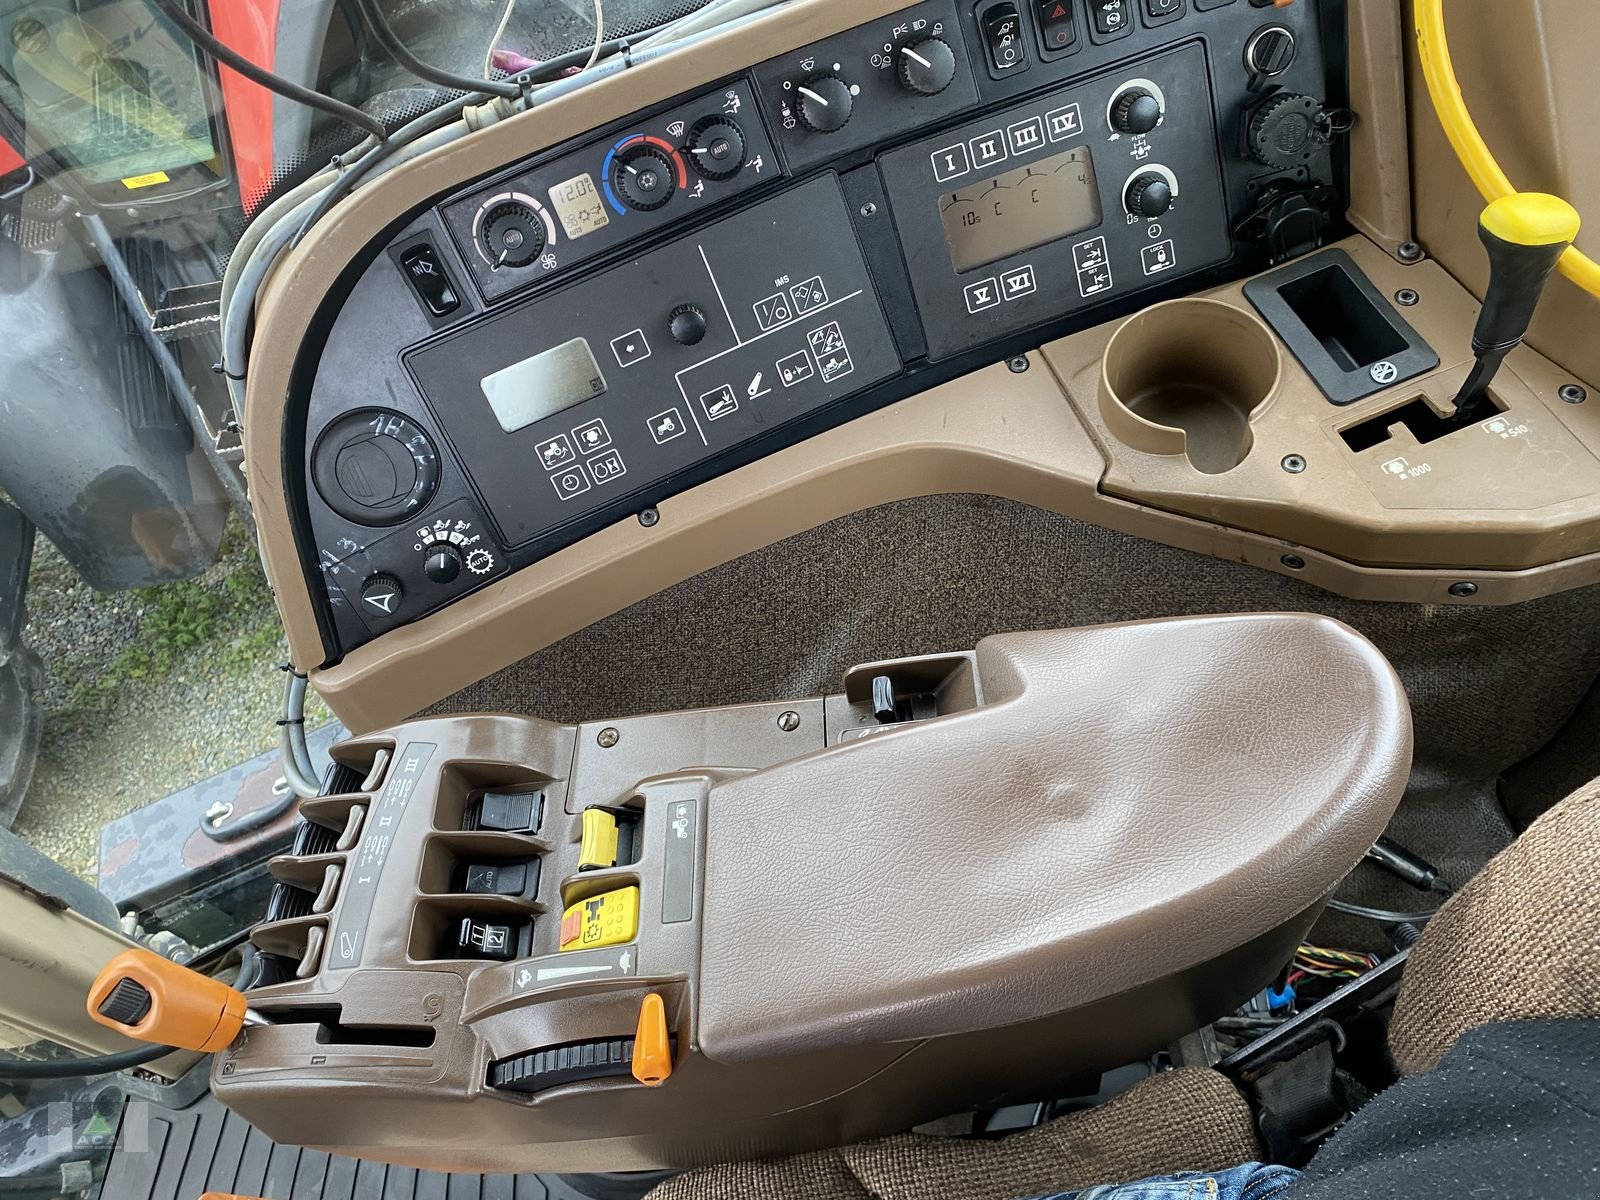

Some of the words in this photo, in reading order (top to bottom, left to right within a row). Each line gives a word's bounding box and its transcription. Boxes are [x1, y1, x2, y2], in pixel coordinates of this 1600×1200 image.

[1052, 112, 1077, 134] IV
[1014, 125, 1039, 147] III
[1131, 133, 1146, 142] FLOW
[714, 143, 728, 155] AUTO
[980, 140, 997, 160] II
[945, 154, 956, 172] I
[593, 216, 608, 227] AUTO
[962, 211, 981, 226] 10s
[506, 233, 520, 244] AUTO
[1150, 244, 1164, 253] LOCK
[774, 274, 790, 288] IMS
[1007, 272, 1031, 293] VI
[973, 286, 991, 304] V
[1508, 424, 1529, 438] 540
[1407, 462, 1432, 478] 1000
[471, 555, 488, 568] AUTO
[404, 758, 419, 773] III
[379, 816, 392, 827] II
[358, 876, 371, 884] I
[486, 871, 494, 889] AUTO
[488, 935, 503, 944] 2
